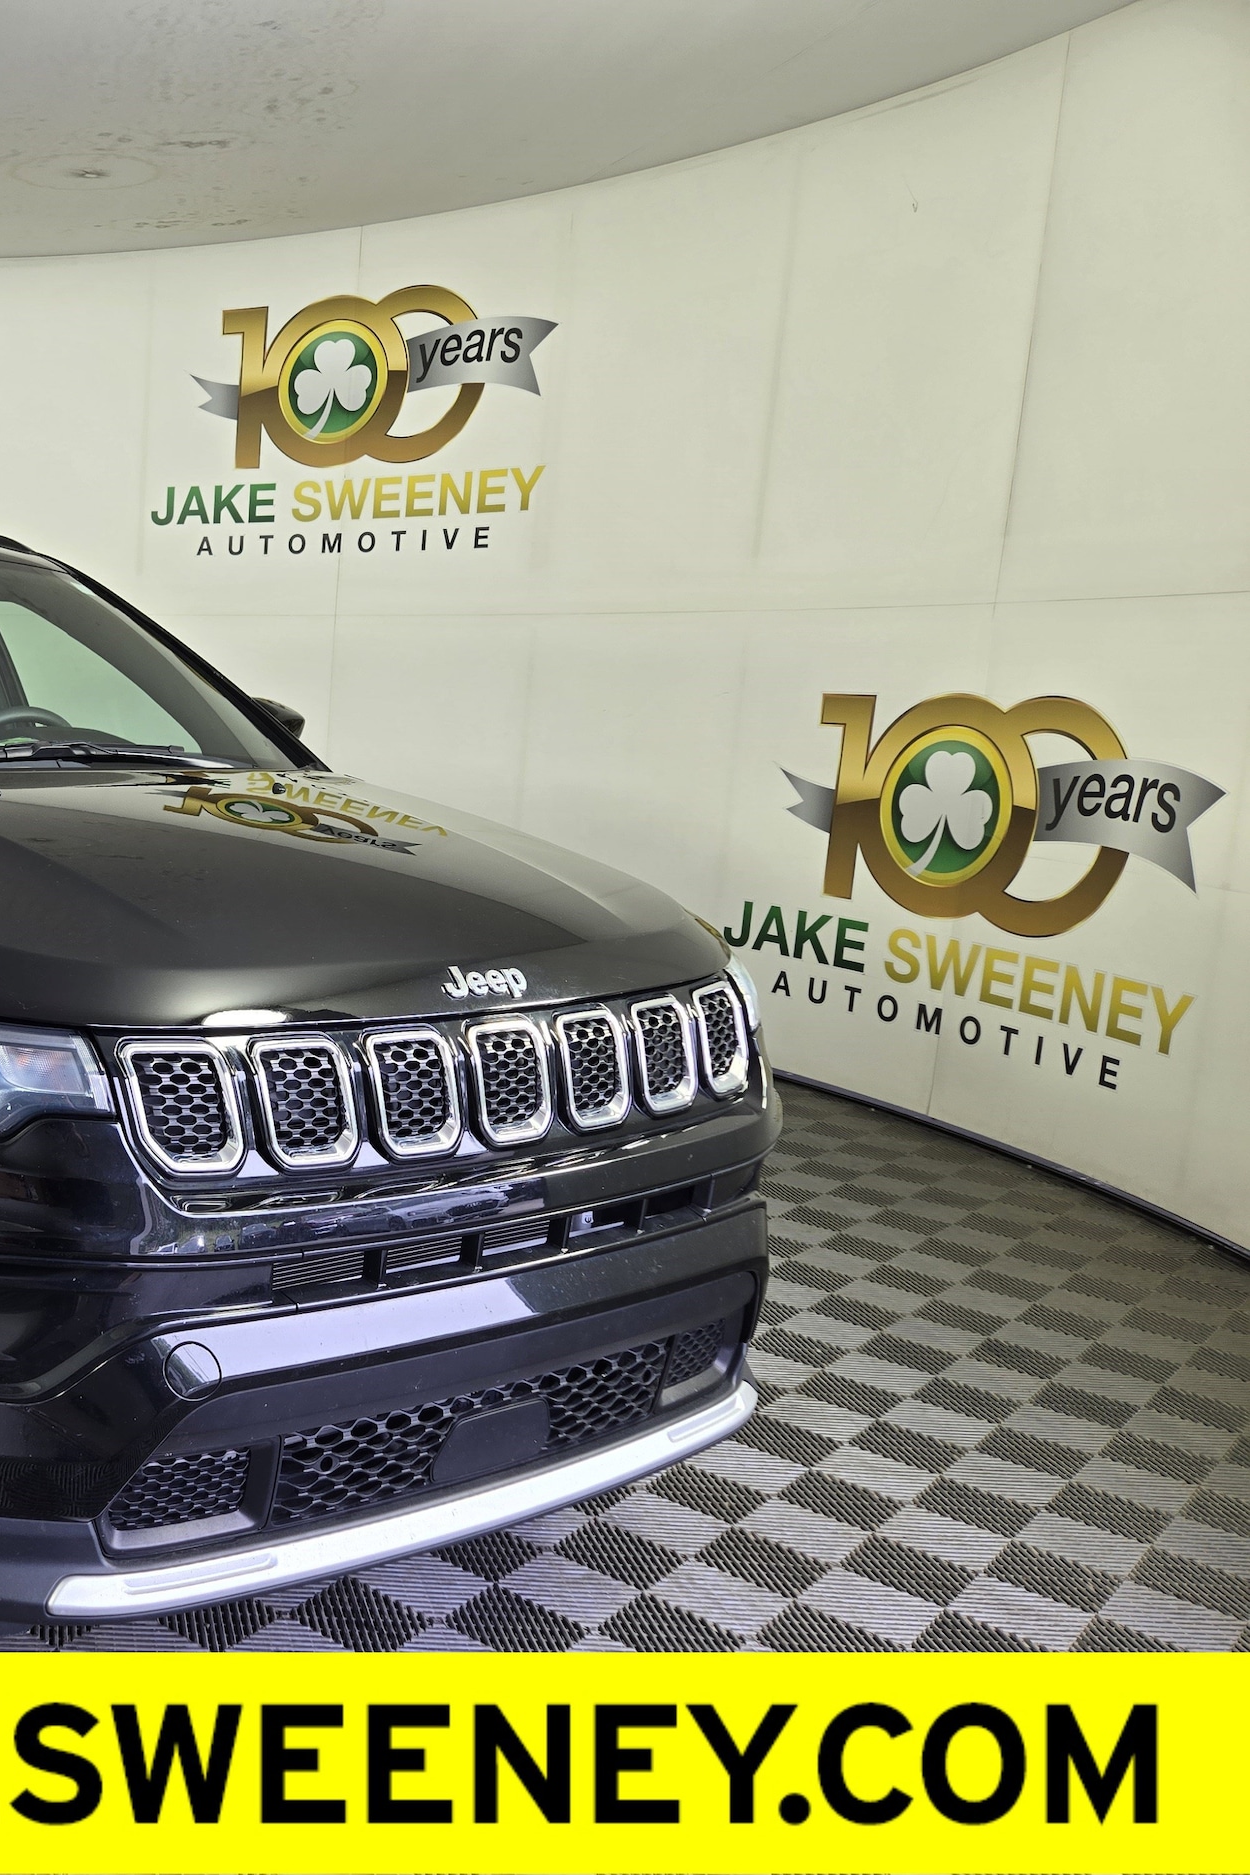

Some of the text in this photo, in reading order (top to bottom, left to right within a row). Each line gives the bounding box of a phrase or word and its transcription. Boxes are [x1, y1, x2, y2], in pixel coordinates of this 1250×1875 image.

[222, 284, 523, 469] 100 years
[150, 465, 546, 527] JAKE SWEENEY
[196, 526, 490, 556] AUTOMOTIVE
[820, 692, 1181, 937] 100 years
[440, 965, 527, 1000] Jeep
[723, 900, 1196, 1056] JAKE SWEENEY
[772, 970, 1121, 1090] AUTOMOTIVE
